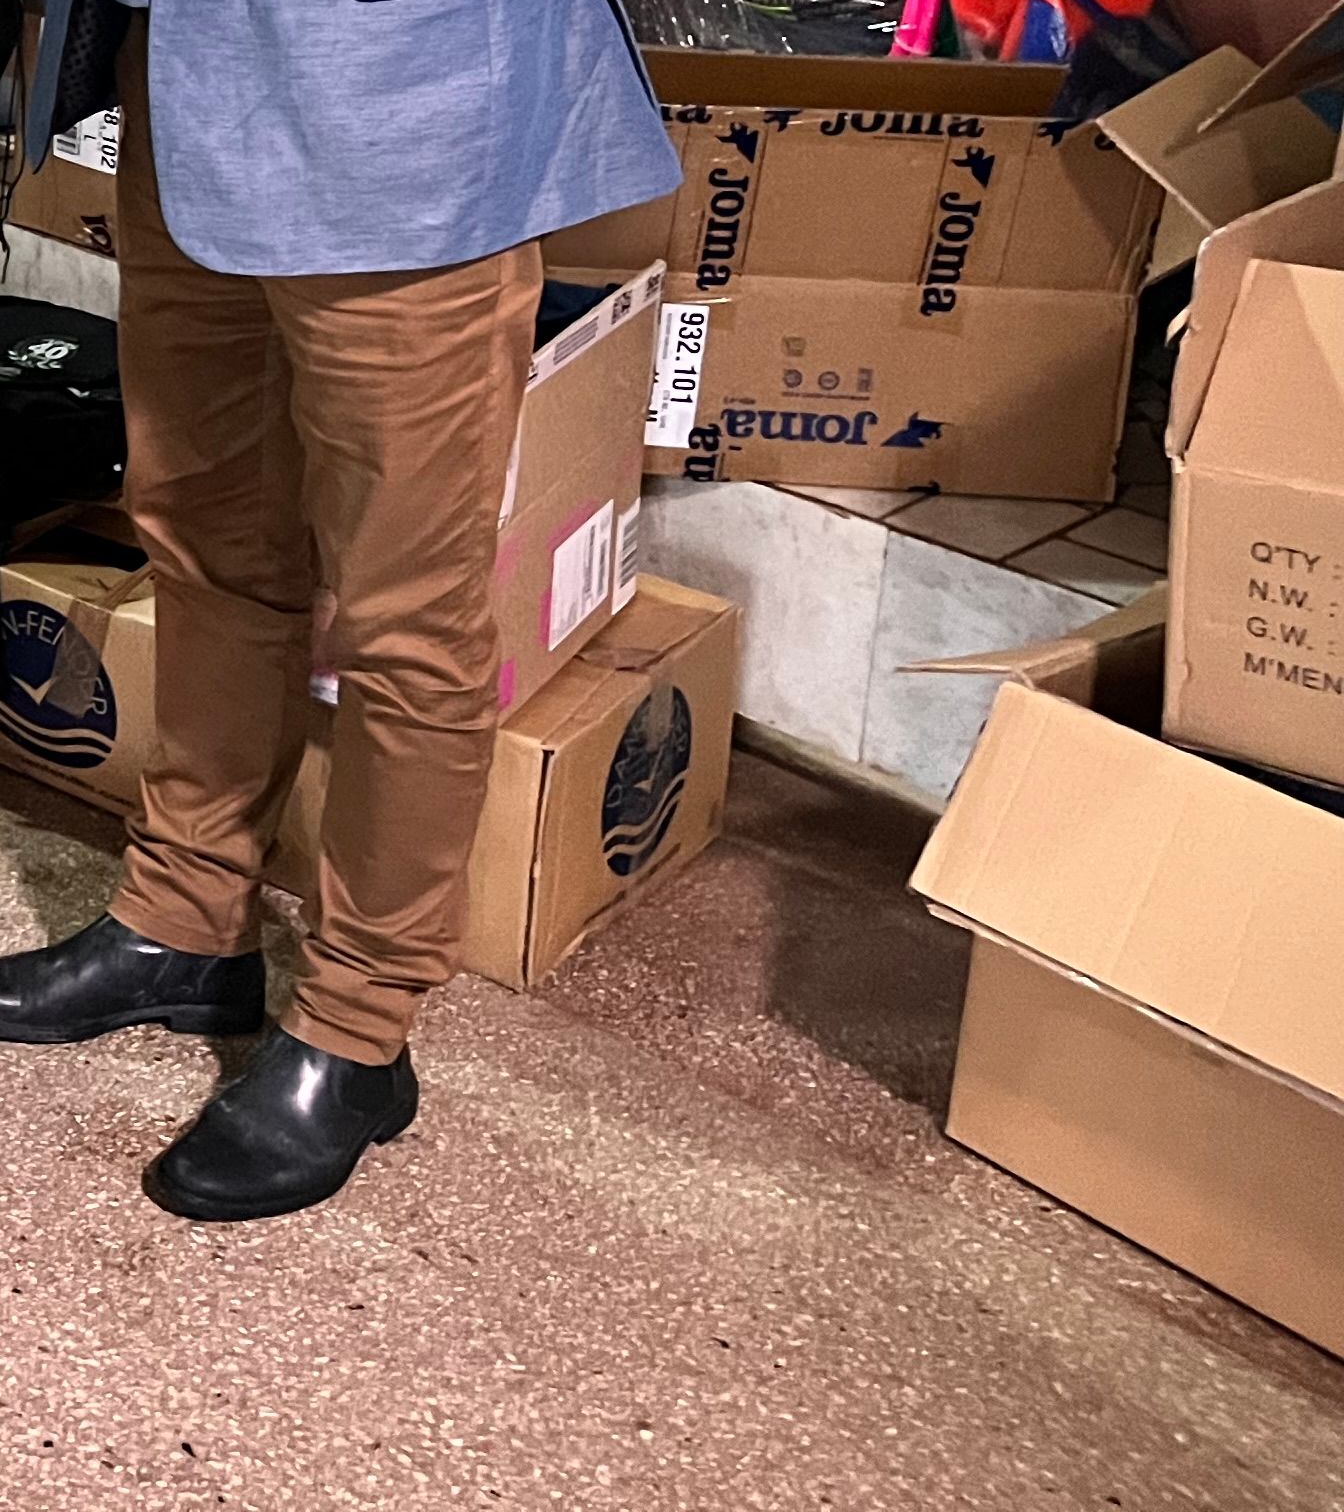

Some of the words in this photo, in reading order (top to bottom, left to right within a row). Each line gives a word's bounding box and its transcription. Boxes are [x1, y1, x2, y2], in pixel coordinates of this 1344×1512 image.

[695, 168, 750, 292] Joma
[919, 191, 982, 317] Joma
[669, 311, 706, 405] 932.101
[719, 407, 879, 447] Joma
[1250, 541, 1321, 574] Q'TY
[1248, 577, 1315, 612] N.W.
[1246, 615, 1315, 651] G.W.
